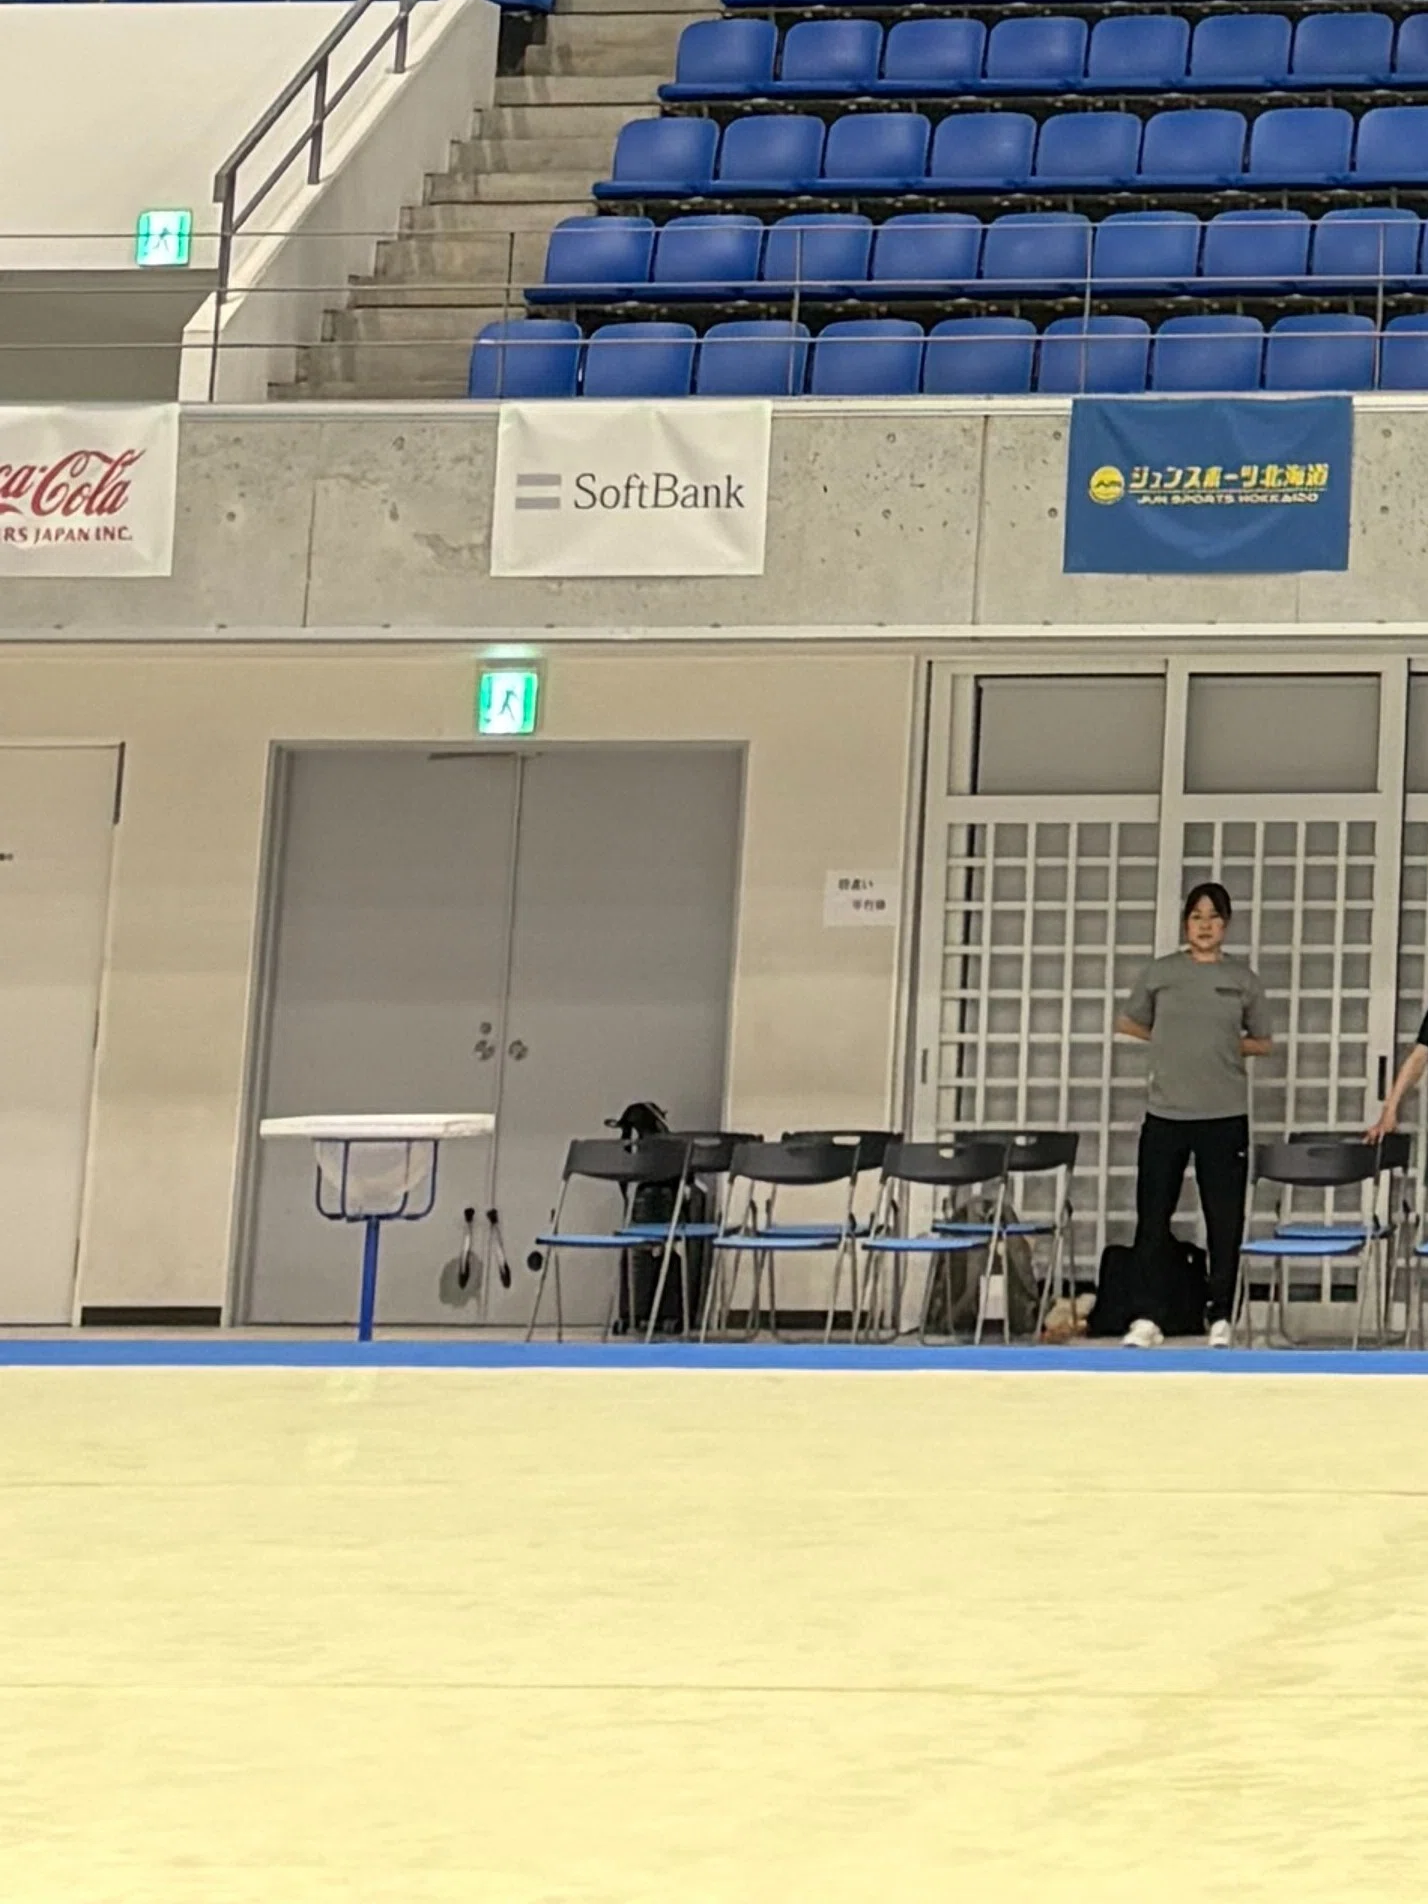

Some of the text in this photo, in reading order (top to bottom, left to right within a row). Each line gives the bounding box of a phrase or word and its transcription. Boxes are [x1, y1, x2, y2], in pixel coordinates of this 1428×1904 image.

[573, 472, 745, 510] SoftBank
[34, 528, 90, 543] JAPAN
[96, 527, 133, 542] INC.
